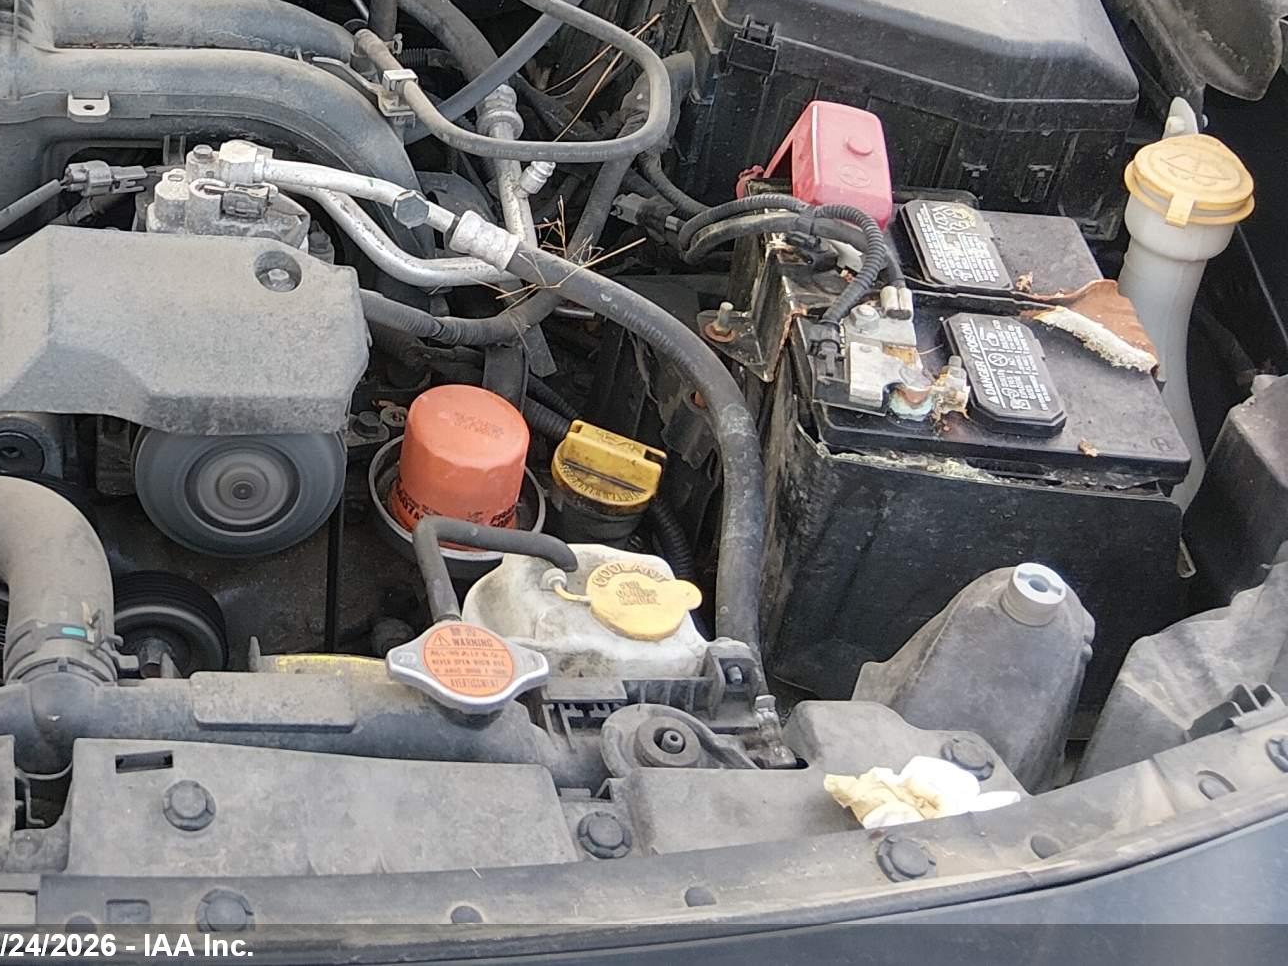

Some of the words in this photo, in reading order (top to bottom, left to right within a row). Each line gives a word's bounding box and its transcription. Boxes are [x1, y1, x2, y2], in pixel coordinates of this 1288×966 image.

[960, 322, 981, 353] POISON
[974, 360, 996, 395] DANGER
[592, 562, 670, 587] COOLANT
[451, 637, 494, 647] WARNING
